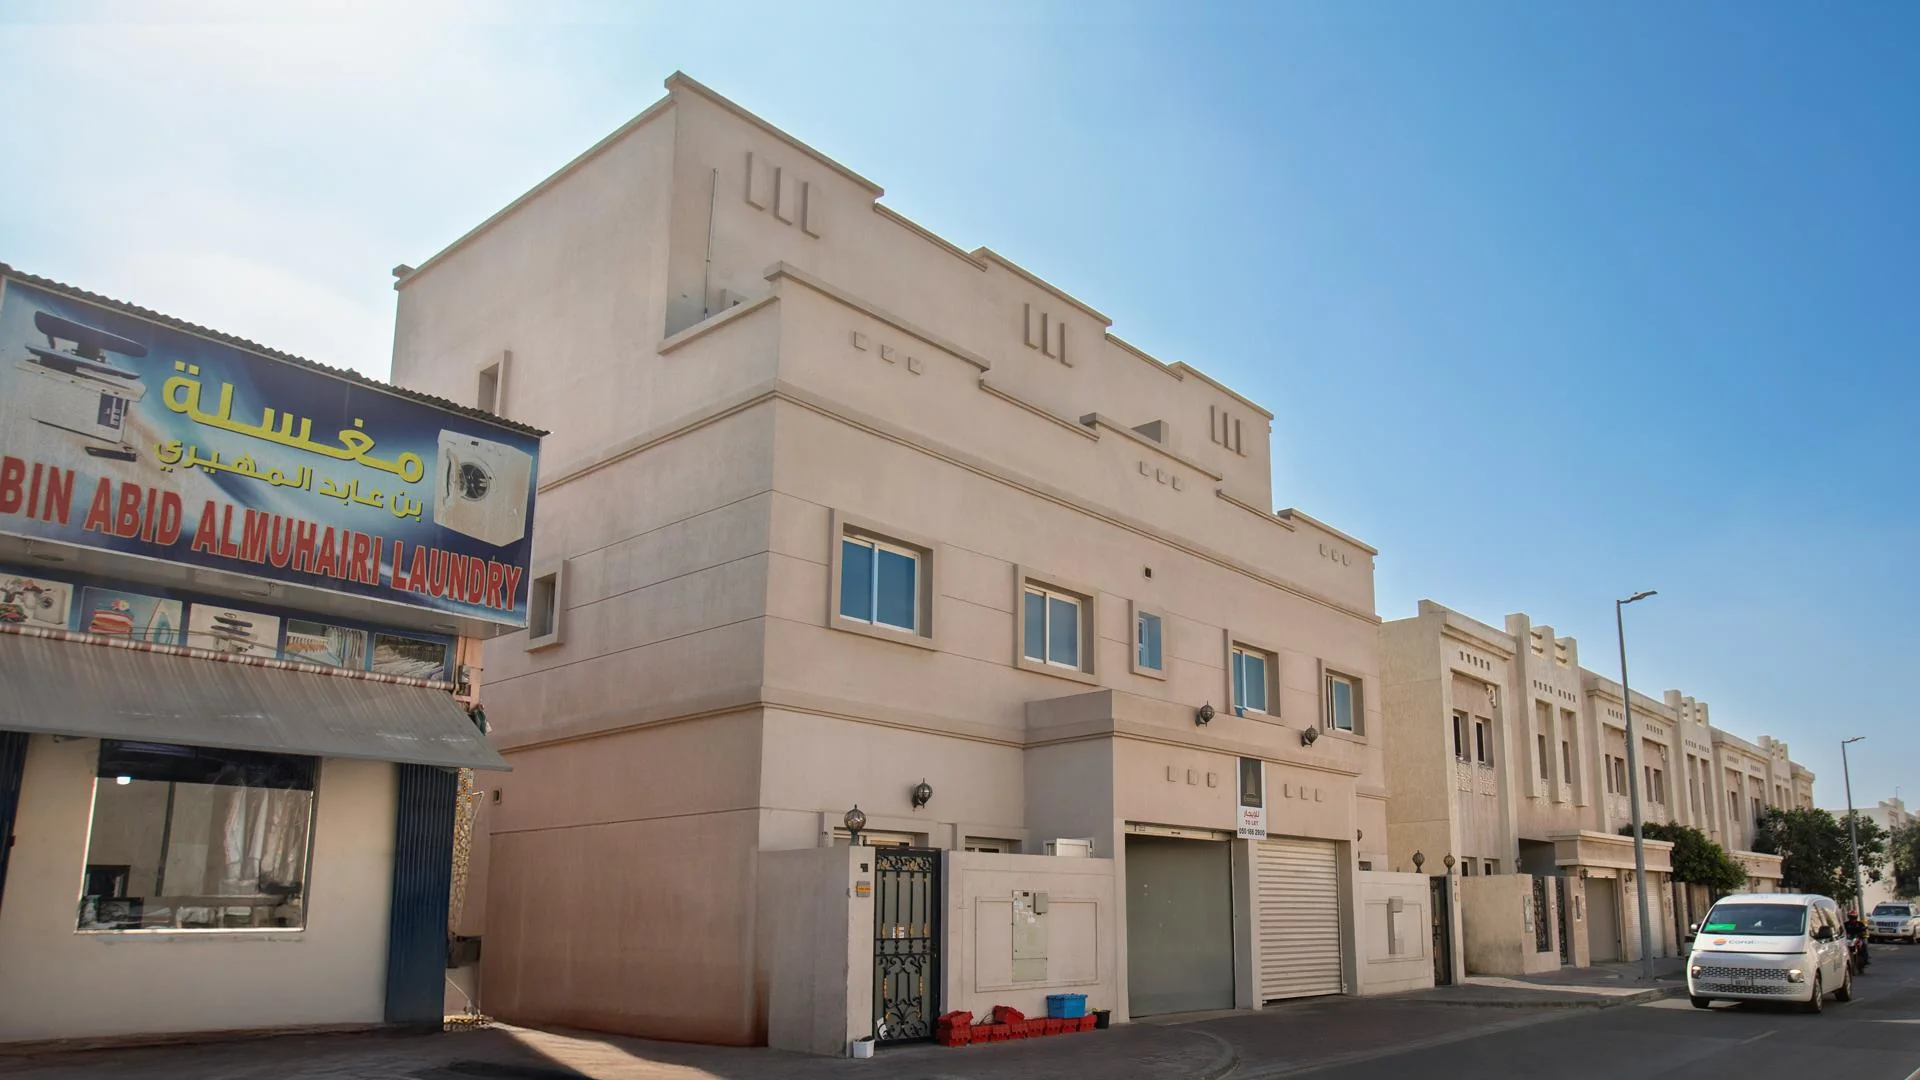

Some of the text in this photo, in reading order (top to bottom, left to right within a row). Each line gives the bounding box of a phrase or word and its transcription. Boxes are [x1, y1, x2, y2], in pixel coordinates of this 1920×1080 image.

[154, 438, 423, 522] بن عابد المهيري
[162, 361, 425, 484] مغسلة
[0, 456, 523, 611] BIN ABID ALMUHAIRI LAUNDRY
